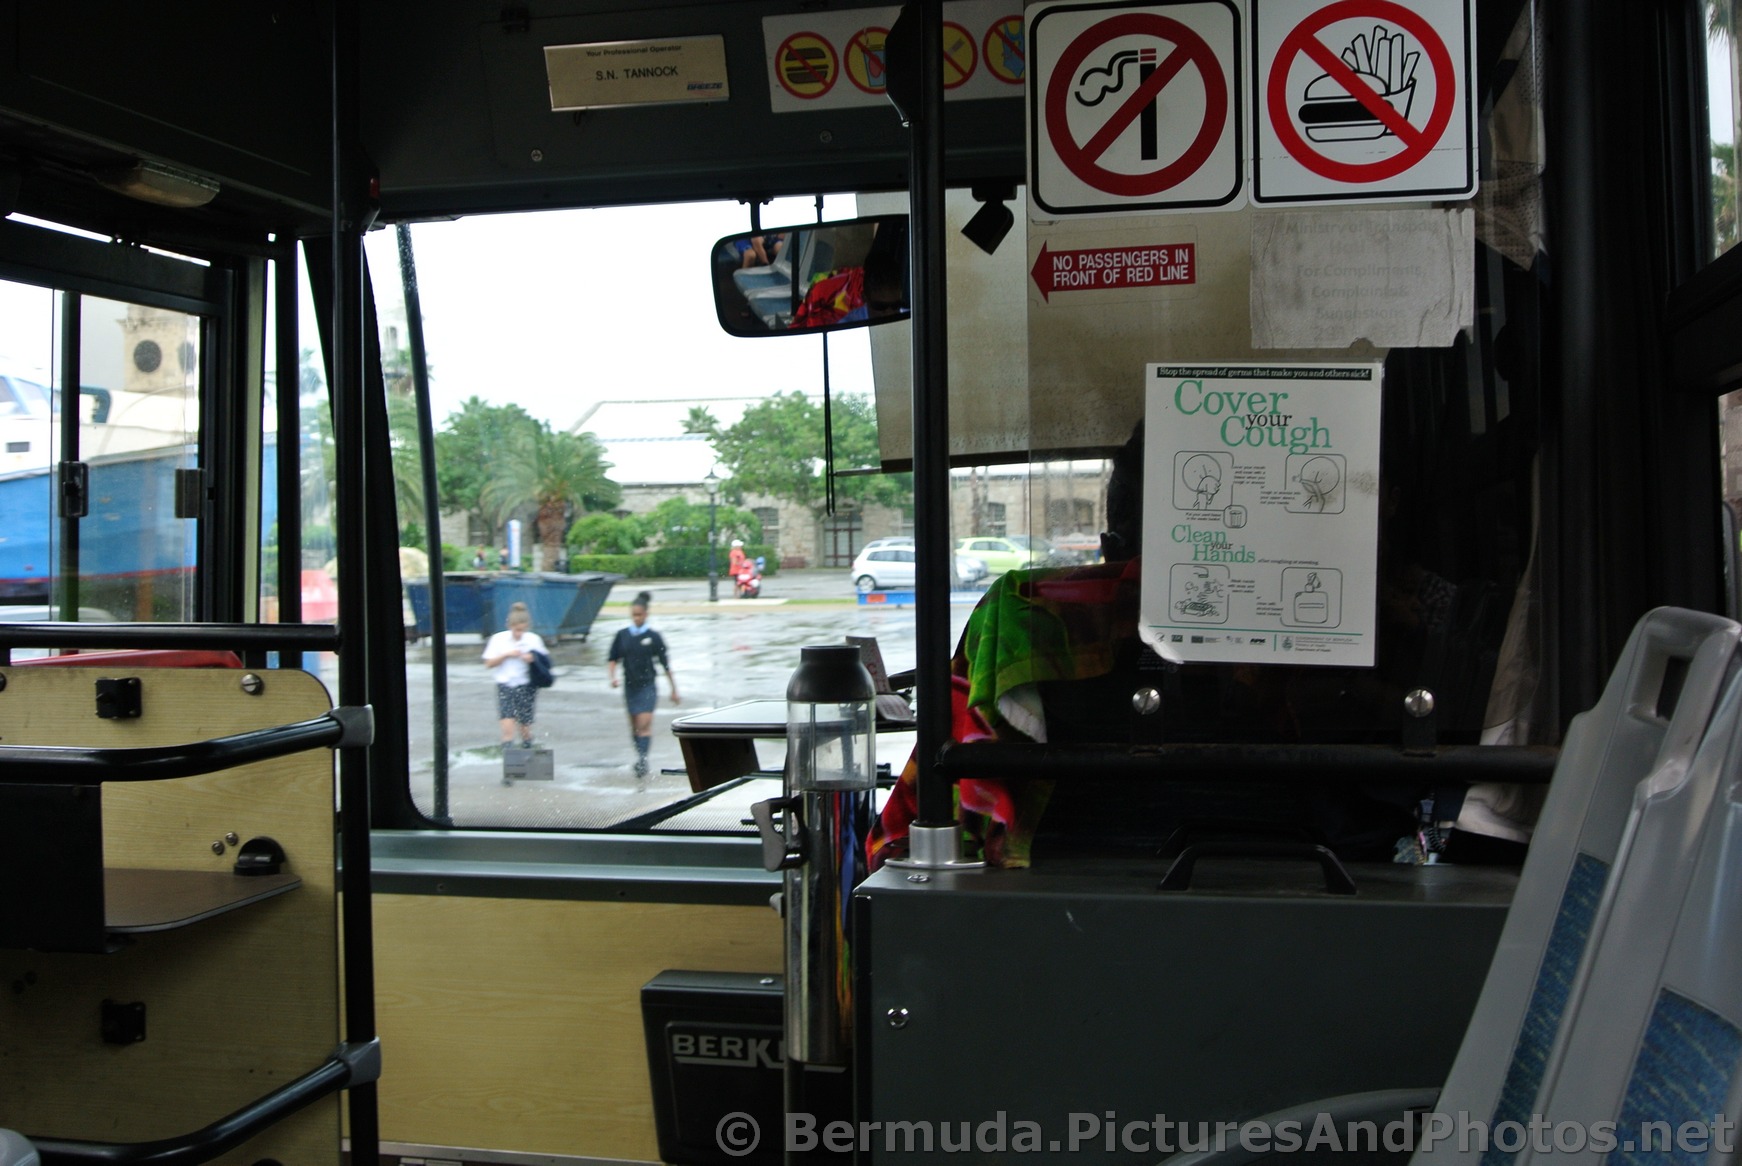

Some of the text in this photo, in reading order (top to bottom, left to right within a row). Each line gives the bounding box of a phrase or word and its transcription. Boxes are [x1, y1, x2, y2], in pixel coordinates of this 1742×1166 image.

[603, 47, 648, 56] Professional
[650, 45, 682, 54] Operator
[595, 65, 679, 81] S.N. TANNOCK
[1053, 248, 1189, 271] NO PASSENGERS IN
[1053, 264, 1189, 287] FRONT OF RED LINE
[1160, 367, 1369, 379] Stop the spread of germs that make you and others sick!
[1174, 380, 1289, 416] Cover
[1245, 412, 1293, 430] your
[1220, 416, 1333, 455] Cough
[1171, 524, 1227, 545] Clean
[1192, 543, 1256, 563] Hands
[1209, 541, 1234, 551] your
[672, 1034, 785, 1069] BERK
